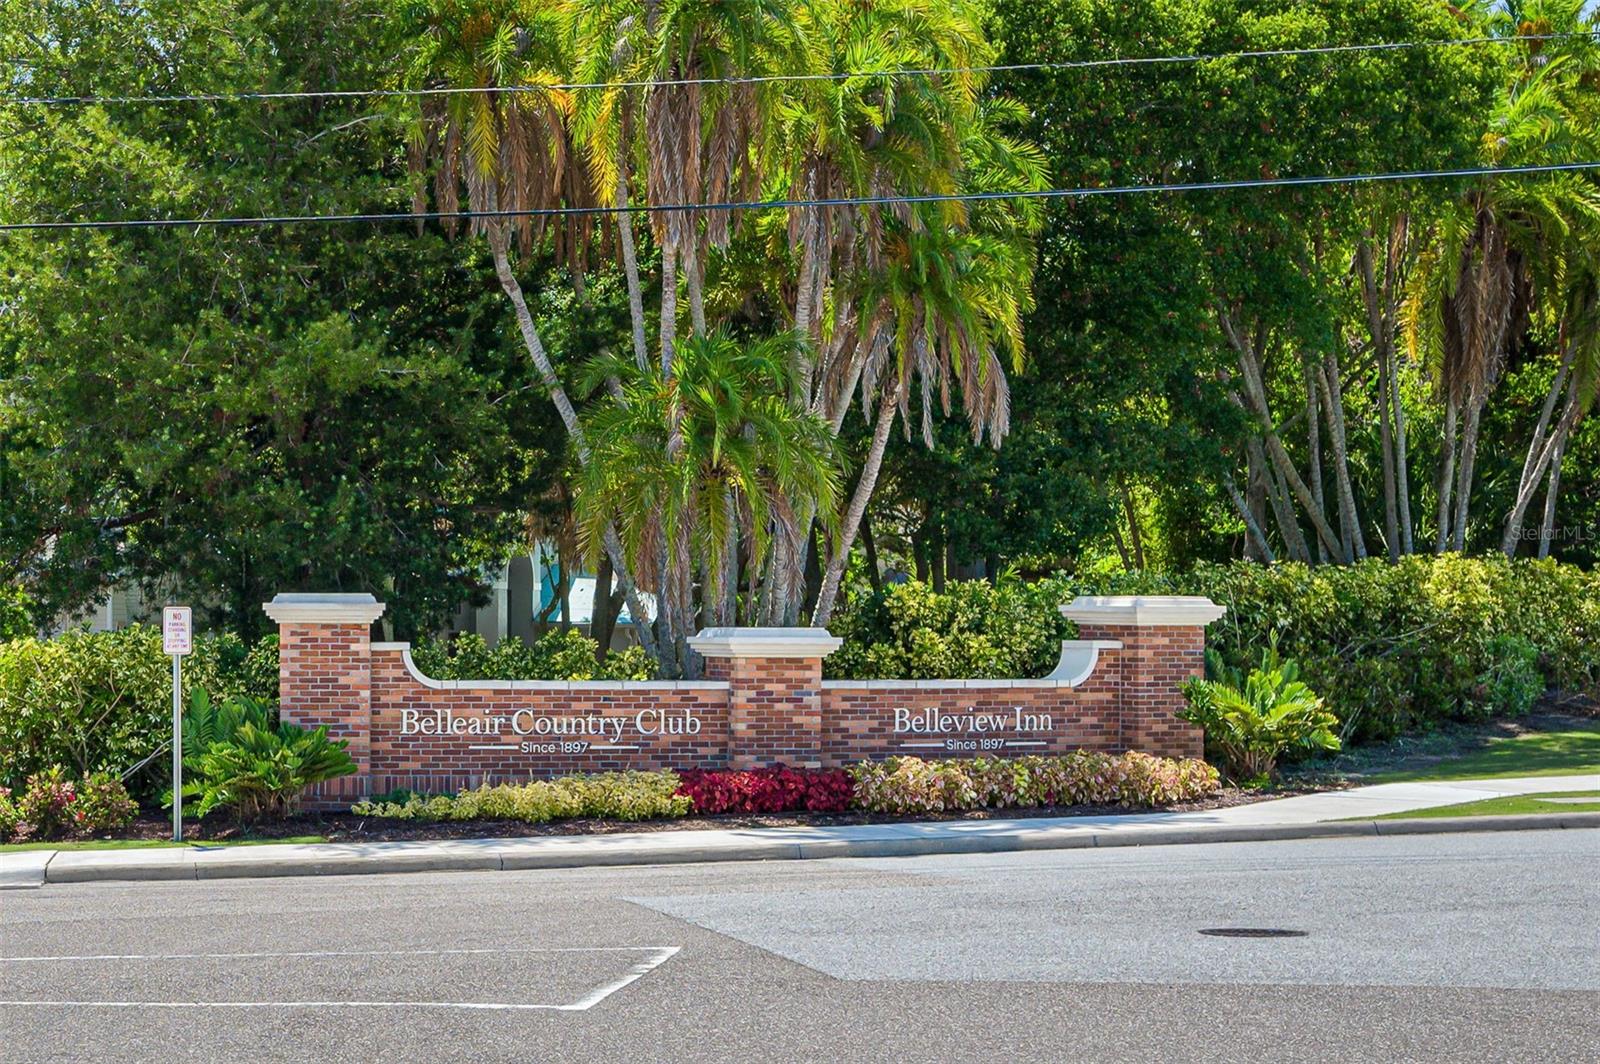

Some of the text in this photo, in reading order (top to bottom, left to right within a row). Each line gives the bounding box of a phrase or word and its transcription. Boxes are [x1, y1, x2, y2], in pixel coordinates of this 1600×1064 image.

[172, 612, 182, 621] NO
[892, 706, 1053, 733] Belleview Inn
[400, 709, 701, 743] Belleair Country Club
[521, 741, 588, 753] Since 1897
[946, 738, 1004, 750] Since 1897
